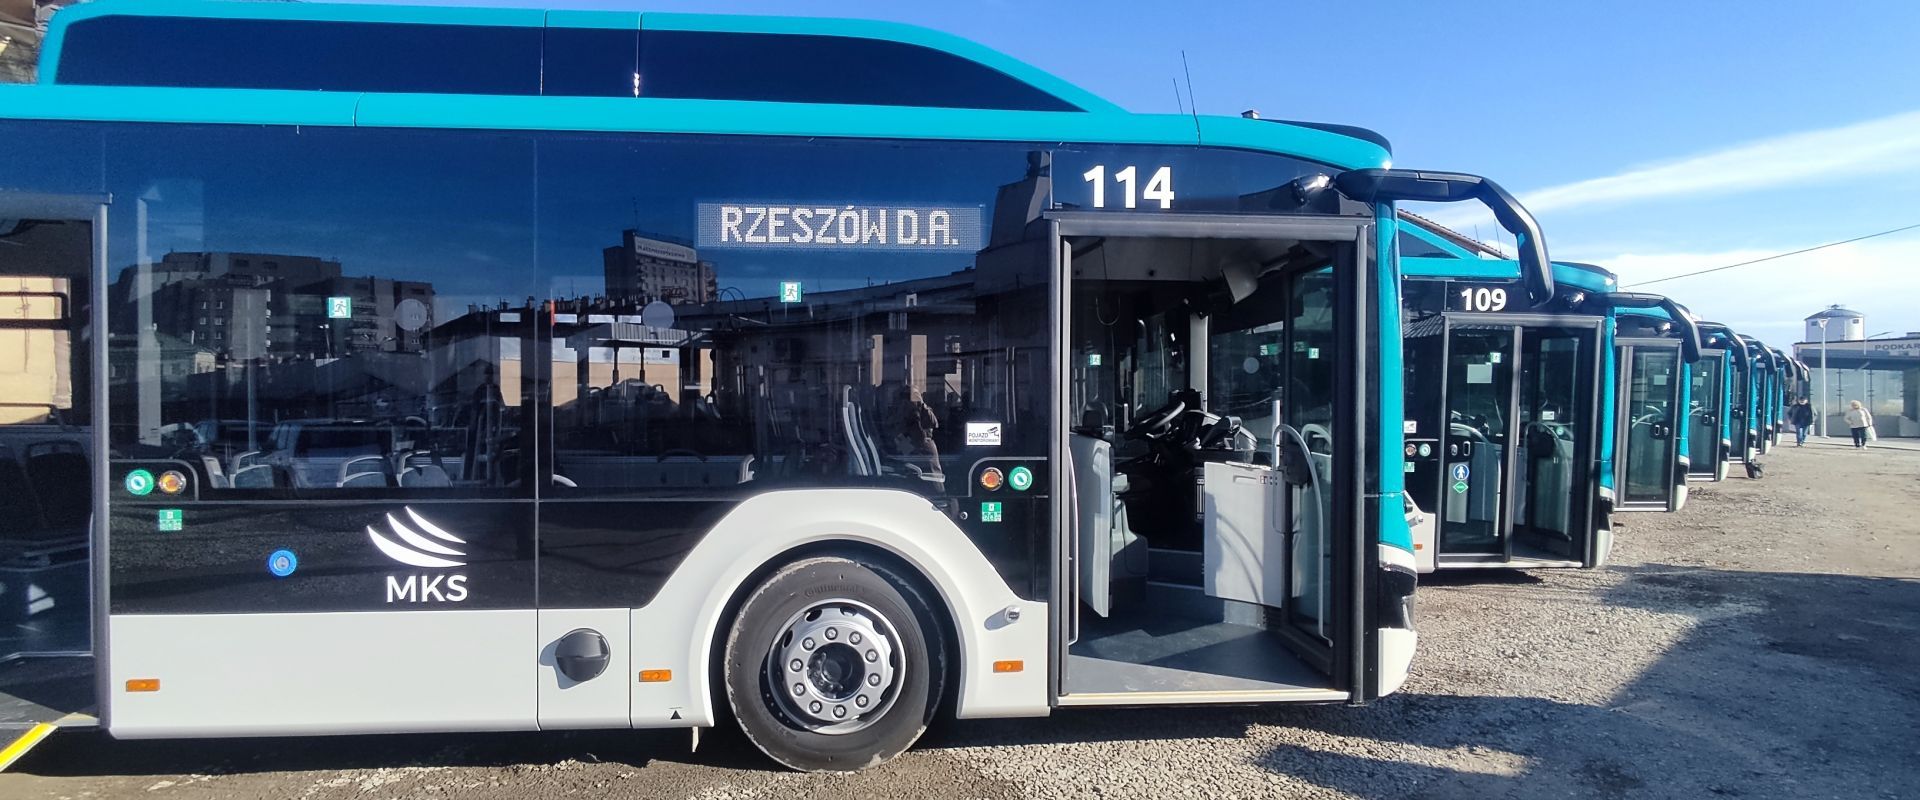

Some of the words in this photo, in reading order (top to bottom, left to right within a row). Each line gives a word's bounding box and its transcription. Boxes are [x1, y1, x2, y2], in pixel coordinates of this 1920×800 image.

[1083, 165, 1175, 209] 114
[721, 205, 886, 244] RZESZÓW
[897, 209, 958, 245] D.A.
[1461, 288, 1507, 312] 109
[386, 574, 468, 603] MKS
